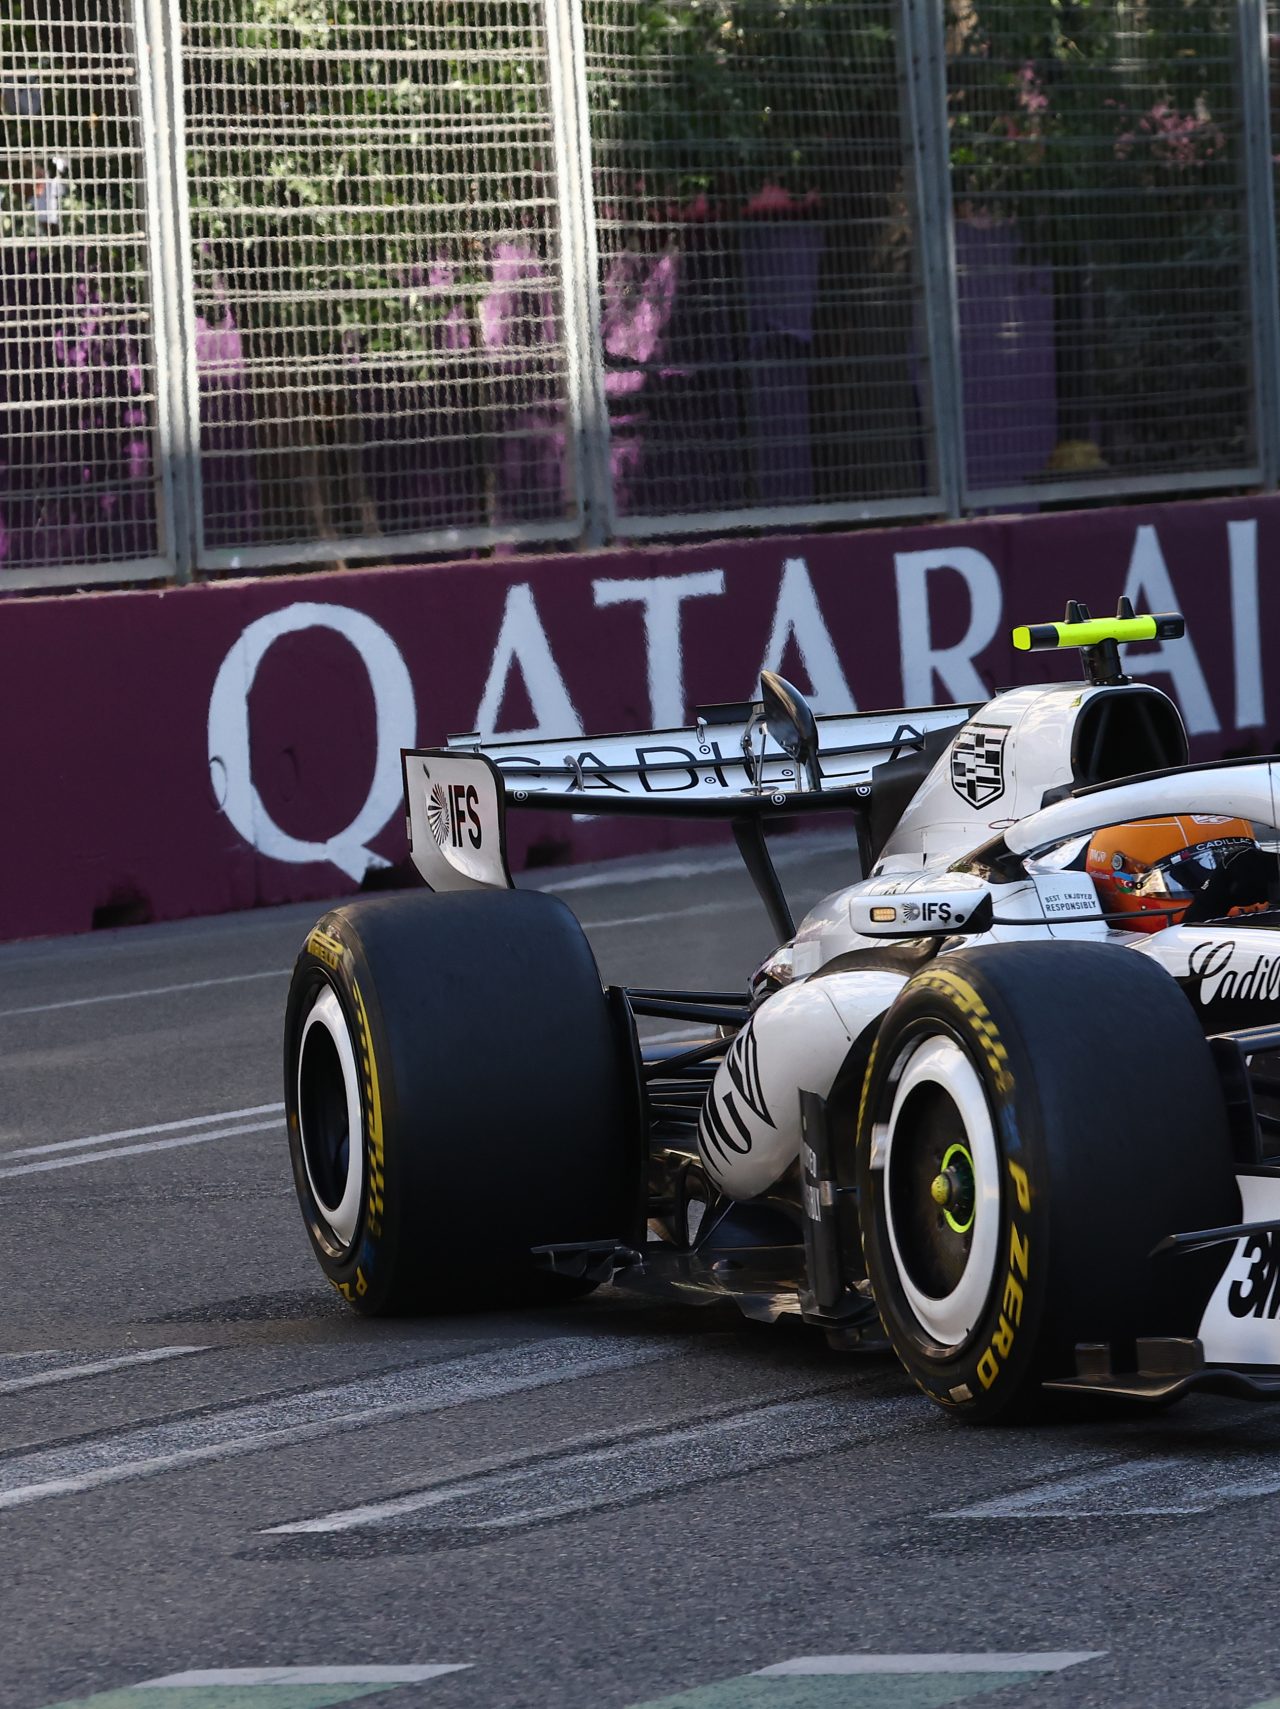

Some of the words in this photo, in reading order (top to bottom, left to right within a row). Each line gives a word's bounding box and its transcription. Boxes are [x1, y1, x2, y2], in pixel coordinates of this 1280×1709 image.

[207, 545, 1001, 884] QATAR
[448, 784, 482, 850] IFS
[922, 902, 951, 923] IFS
[1045, 894, 1061, 903] BEST
[1045, 900, 1097, 912] RESPONSIBLY
[1008, 1158, 1031, 1214] P
[976, 1220, 1030, 1390] ZERO
